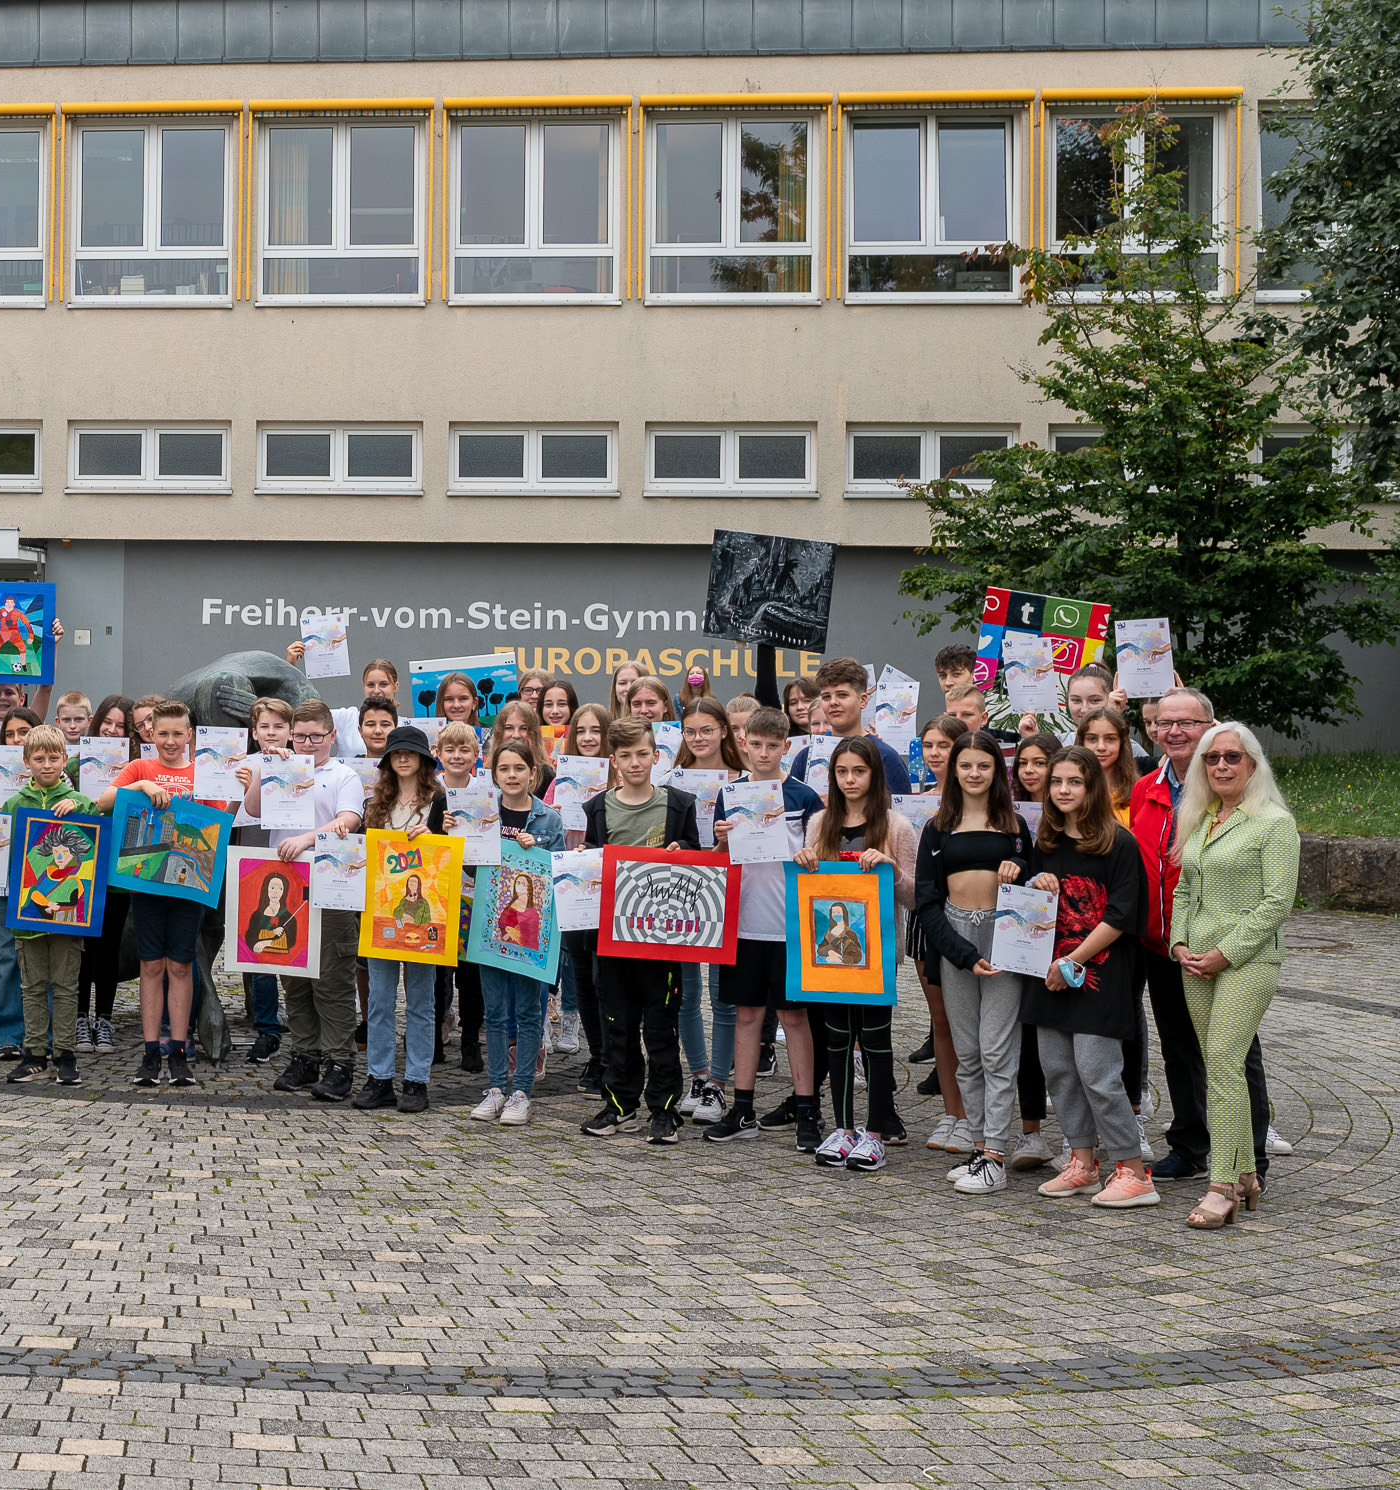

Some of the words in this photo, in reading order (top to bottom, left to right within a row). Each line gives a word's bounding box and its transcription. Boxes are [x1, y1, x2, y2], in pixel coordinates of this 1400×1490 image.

[202, 598, 705, 638] Freiherr-vom-Stein-Gymn
[494, 647, 821, 677] UROPASCHULE
[387, 848, 422, 873] 2021
[629, 911, 655, 930] ist
[665, 916, 701, 933] cool
